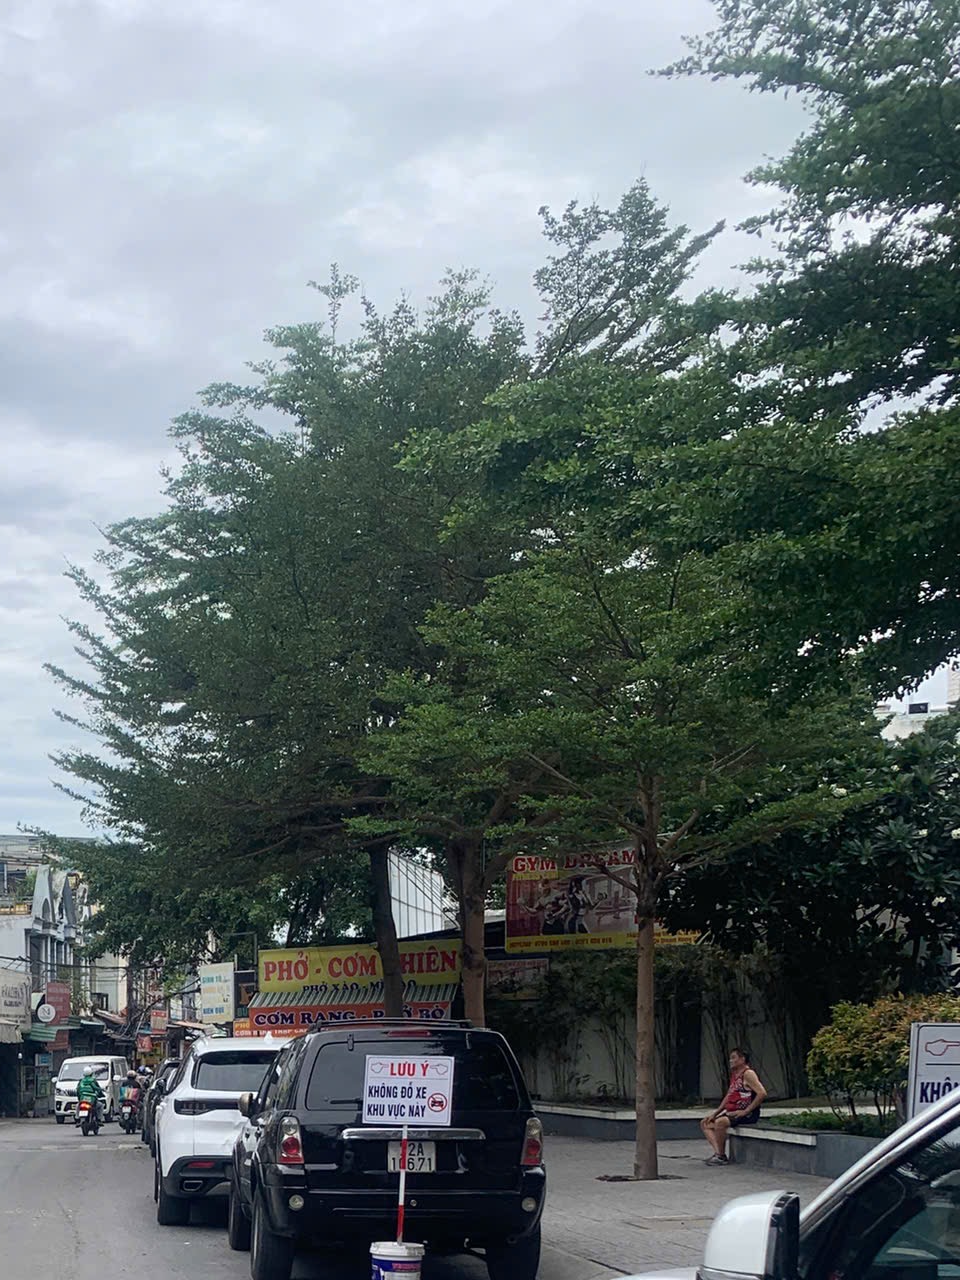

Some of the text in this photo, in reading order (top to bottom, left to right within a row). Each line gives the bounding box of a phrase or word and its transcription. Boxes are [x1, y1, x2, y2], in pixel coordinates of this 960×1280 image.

[512, 856, 558, 873] GYM
[264, 951, 310, 981] PHỞ
[328, 953, 377, 978] CƠM
[400, 945, 457, 974] HIÊN
[254, 1012, 295, 1025] CƠM
[300, 1011, 356, 1024] RANG
[390, 1060, 430, 1077] LƯU Ý
[368, 1081, 427, 1099] KHÔNG ĐỖ XE
[919, 1077, 960, 1103] KHÔ
[367, 1103, 427, 1119] KHU VỰC NÀY
[400, 1143, 424, 1157] 2A
